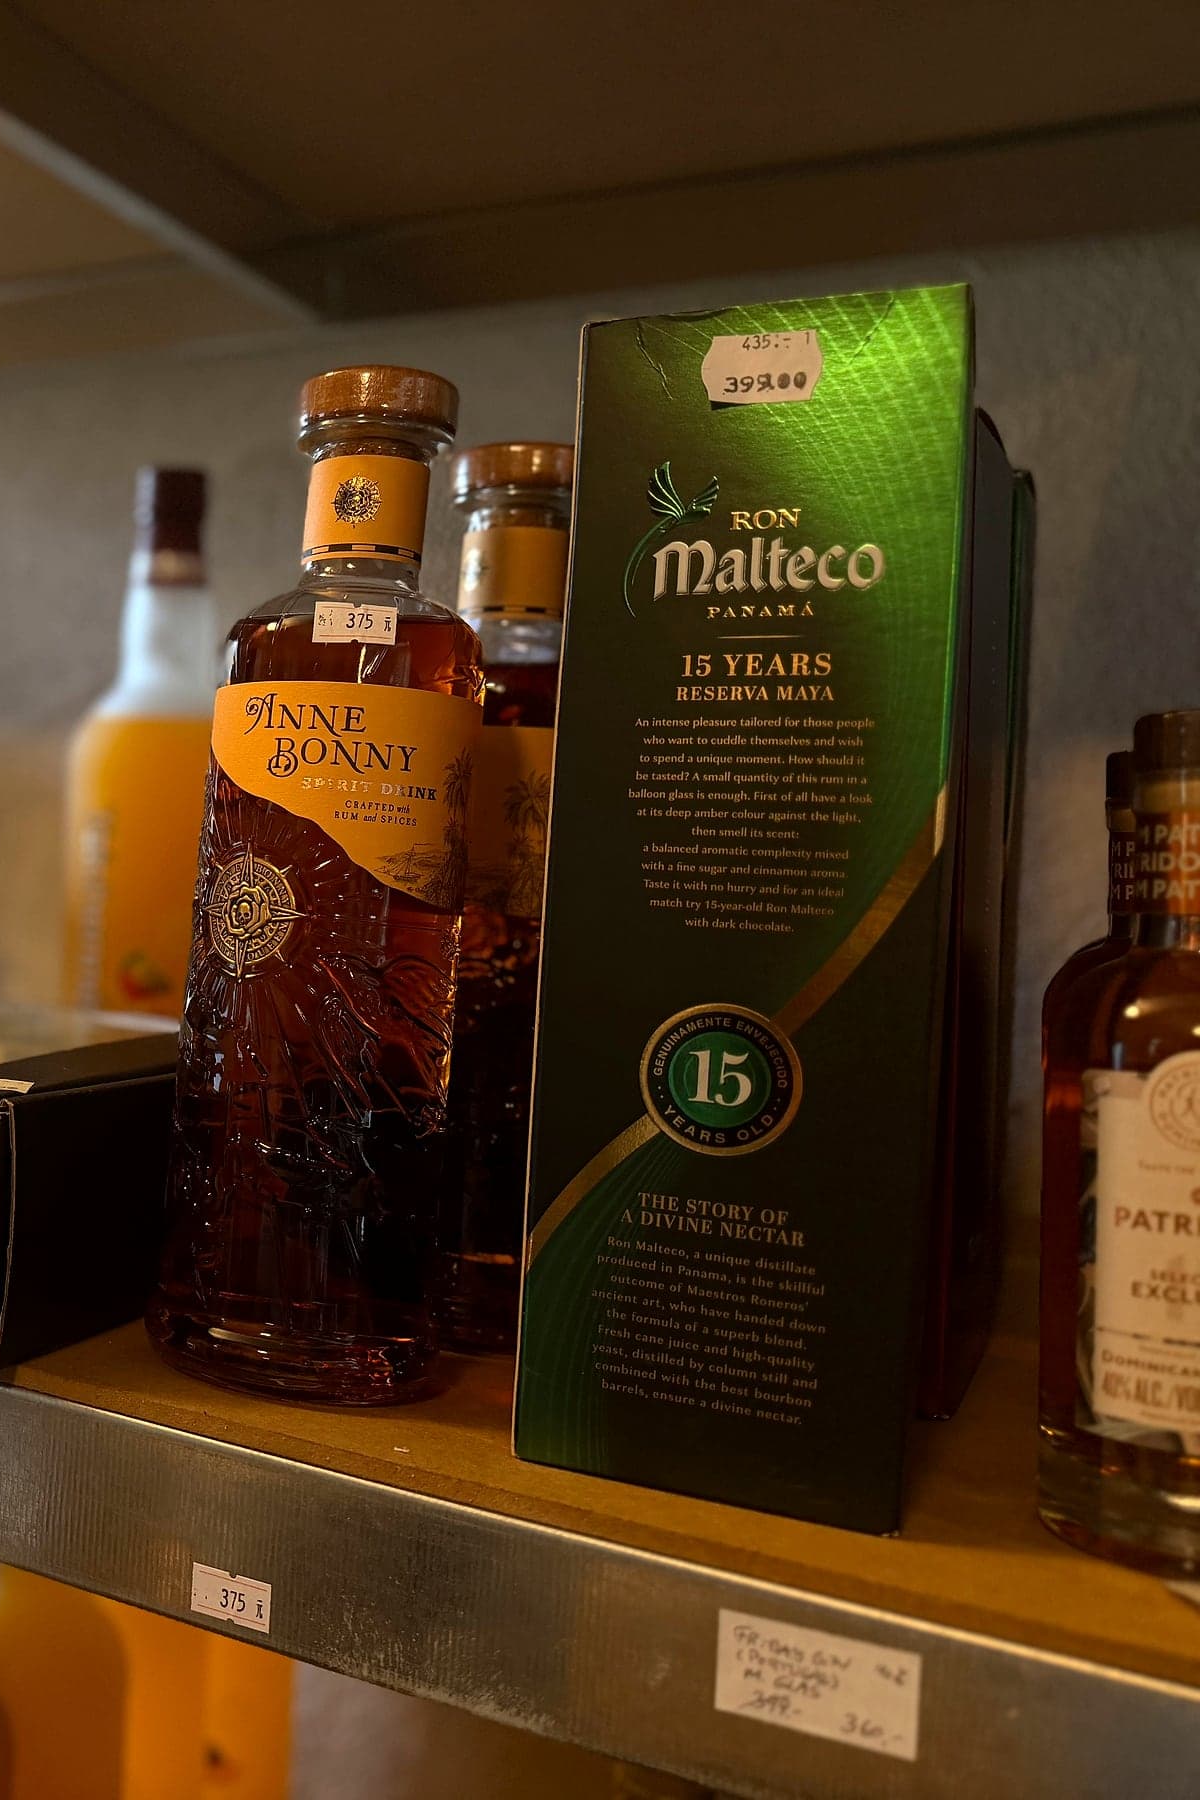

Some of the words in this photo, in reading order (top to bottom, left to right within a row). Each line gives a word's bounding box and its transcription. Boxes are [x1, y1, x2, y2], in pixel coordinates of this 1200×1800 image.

[730, 508, 801, 531] RON
[653, 537, 886, 601] Malteco
[706, 601, 815, 620] PANAMÁ
[345, 612, 374, 630] 375
[681, 654, 712, 678] 15
[723, 652, 832, 677] YEARS
[676, 685, 769, 701] RESERVA
[776, 685, 834, 701] MAYA
[244, 693, 366, 737] ANNE
[634, 718, 648, 726] An
[652, 717, 689, 726] intense
[692, 716, 736, 728] pleasure
[740, 716, 781, 726] tailored
[784, 716, 799, 726] for
[802, 717, 833, 726] those
[836, 718, 874, 729] people
[643, 735, 664, 744] who
[710, 734, 746, 744] cuddle
[750, 735, 810, 745] themselves
[814, 736, 834, 745] and
[838, 736, 863, 745] wish
[267, 737, 417, 778] BONNY
[639, 754, 650, 762] to
[652, 753, 684, 764] spend
[696, 754, 732, 765] unique
[788, 754, 813, 764] How
[816, 754, 853, 764] should
[856, 756, 864, 765] it
[635, 770, 648, 780] be
[651, 771, 689, 780] tasted?
[702, 771, 730, 781] small
[733, 773, 779, 784] quantity
[782, 773, 792, 782] of
[796, 773, 817, 783] this
[301, 777, 372, 794] SPIRIT
[380, 783, 437, 801] DRINK
[628, 788, 665, 798] balloon
[668, 789, 693, 801] glass
[696, 789, 704, 799] is
[707, 790, 750, 802] enough.
[753, 791, 776, 800] First
[780, 791, 791, 801] of
[795, 791, 807, 801] all
[810, 791, 836, 802] have
[848, 793, 872, 803] look
[345, 800, 395, 812] CRAFTED
[650, 807, 662, 816] its
[665, 806, 691, 819] deep
[694, 808, 728, 817] amber
[731, 809, 764, 818] colour
[768, 812, 806, 821] against
[810, 811, 828, 820] the
[832, 811, 860, 823] light,
[334, 810, 359, 821] RUM
[363, 812, 377, 823] and
[380, 815, 417, 827] SPICES
[691, 826, 715, 835] then
[718, 827, 746, 836] smell
[750, 829, 763, 837] its
[651, 842, 698, 853] balanced
[701, 846, 748, 855] aromatic
[751, 847, 811, 858] complexity
[814, 849, 848, 859] mixed
[641, 861, 664, 870] with
[676, 861, 695, 871] fine
[698, 865, 727, 874] sugar
[730, 864, 750, 873] and
[753, 866, 807, 875] cinnamon
[644, 878, 669, 888] Taste
[672, 879, 680, 889] it
[683, 880, 707, 890] with
[726, 882, 756, 895] hurry
[759, 884, 779, 893] and
[783, 884, 797, 894] for
[817, 887, 844, 896] ideal
[649, 897, 682, 907] match
[685, 900, 700, 911] try
[706, 900, 762, 911] 15-year-old
[766, 903, 786, 912] Ron
[790, 904, 834, 914] Malteco
[684, 917, 708, 927] with
[711, 918, 735, 928] dark
[738, 919, 794, 931] chocolate.
[653, 1016, 732, 1076] GENUINAMENTE
[736, 1020, 788, 1089] ENVEJECIDO
[687, 1049, 752, 1107] 15
[664, 1104, 726, 1144] YEARS
[737, 1113, 773, 1141] OLD
[637, 1192, 678, 1211] THE
[686, 1199, 752, 1220] STORY
[760, 1208, 788, 1224] OF
[640, 1211, 712, 1233] DIVINE
[720, 1222, 803, 1246] NECTAR
[607, 1236, 630, 1248] Ron
[705, 1253, 750, 1266] unique
[755, 1258, 815, 1274] distillate
[610, 1275, 664, 1289] outcome
[669, 1282, 681, 1292] of
[687, 1285, 744, 1301] Maestros
[606, 1308, 626, 1319] the
[631, 1311, 679, 1328] formula
[684, 1321, 696, 1331] of
[713, 1328, 759, 1341] superb
[597, 1324, 630, 1338] Fresh
[634, 1333, 663, 1344] cane
[668, 1336, 698, 1350] juice
[703, 1345, 727, 1355] and
[732, 1347, 814, 1371] high-quality
[220, 1588, 246, 1612] 375
